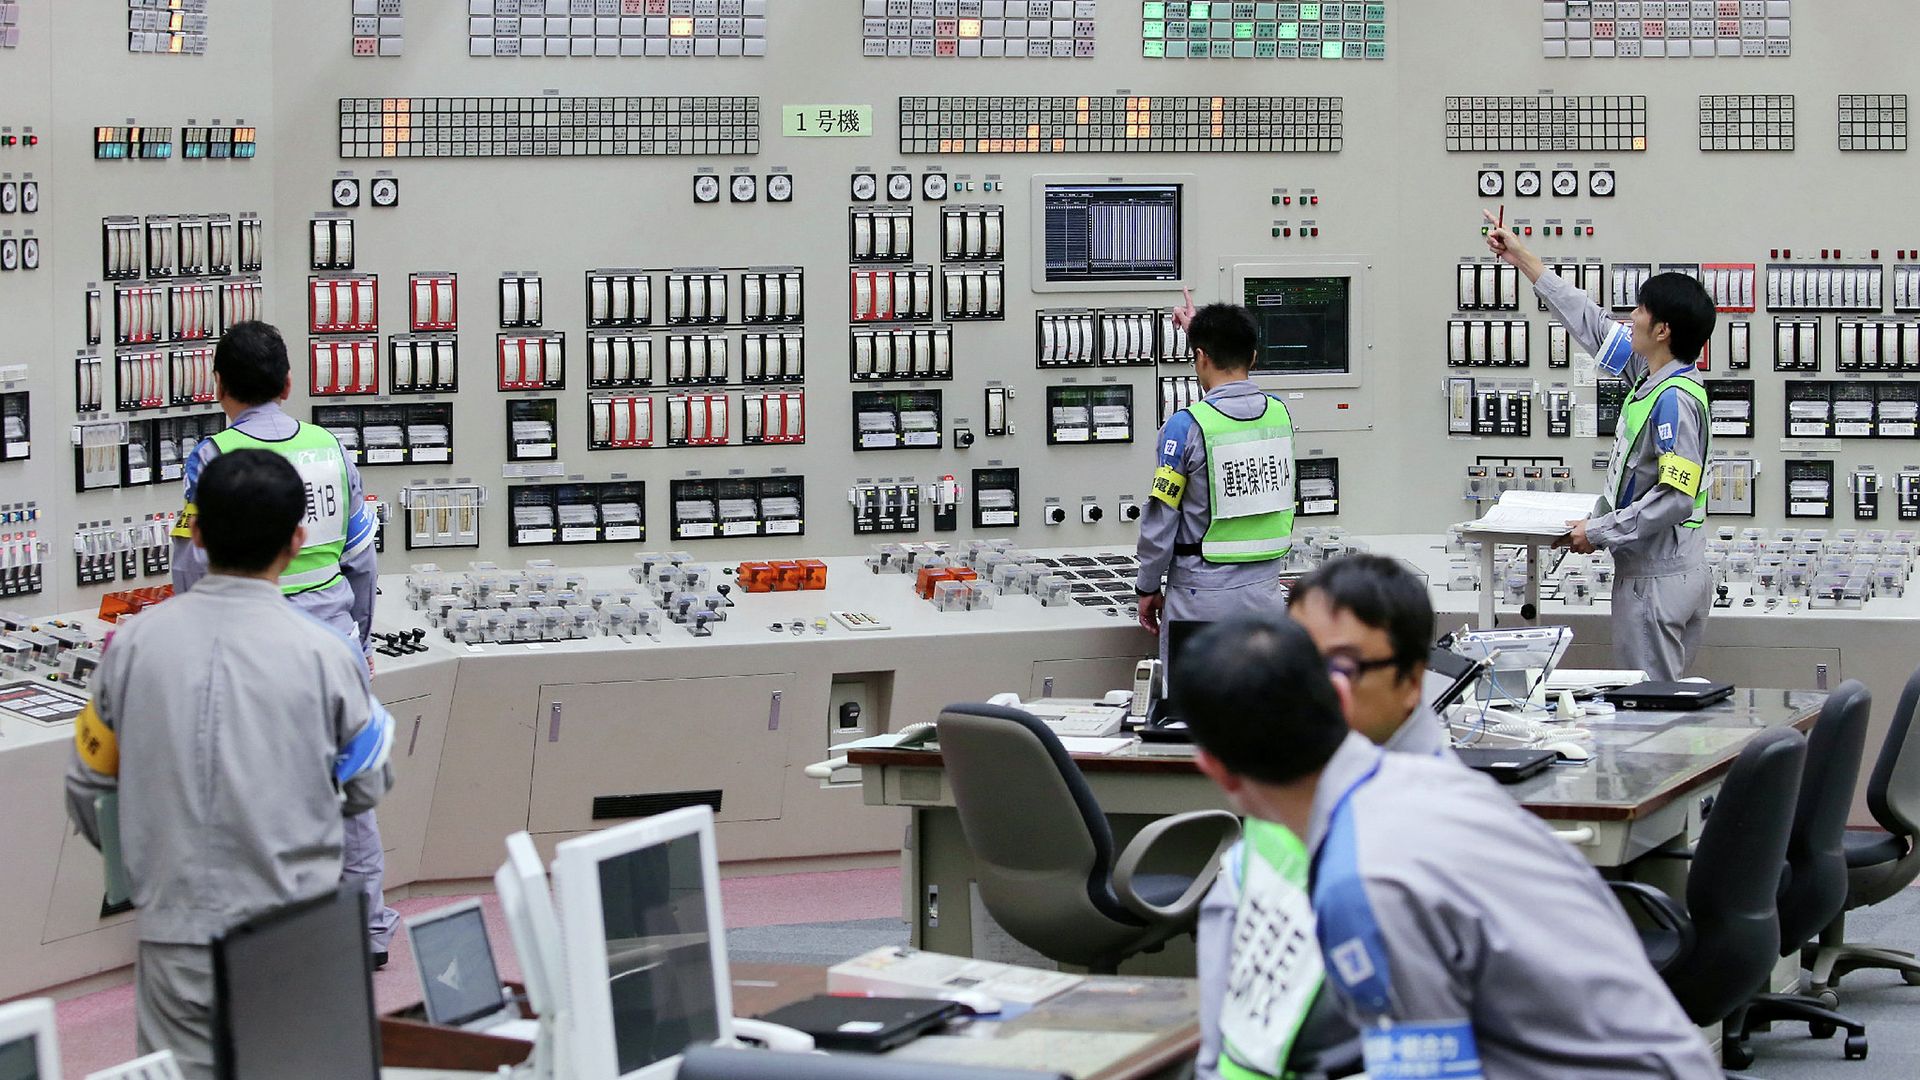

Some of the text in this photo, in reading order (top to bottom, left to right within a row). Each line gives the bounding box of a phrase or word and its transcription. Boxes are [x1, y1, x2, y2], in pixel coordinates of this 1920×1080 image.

[796, 109, 860, 133] 1号機
[1152, 476, 1181, 499] 電課
[1222, 455, 1290, 498] 運転操作員1A
